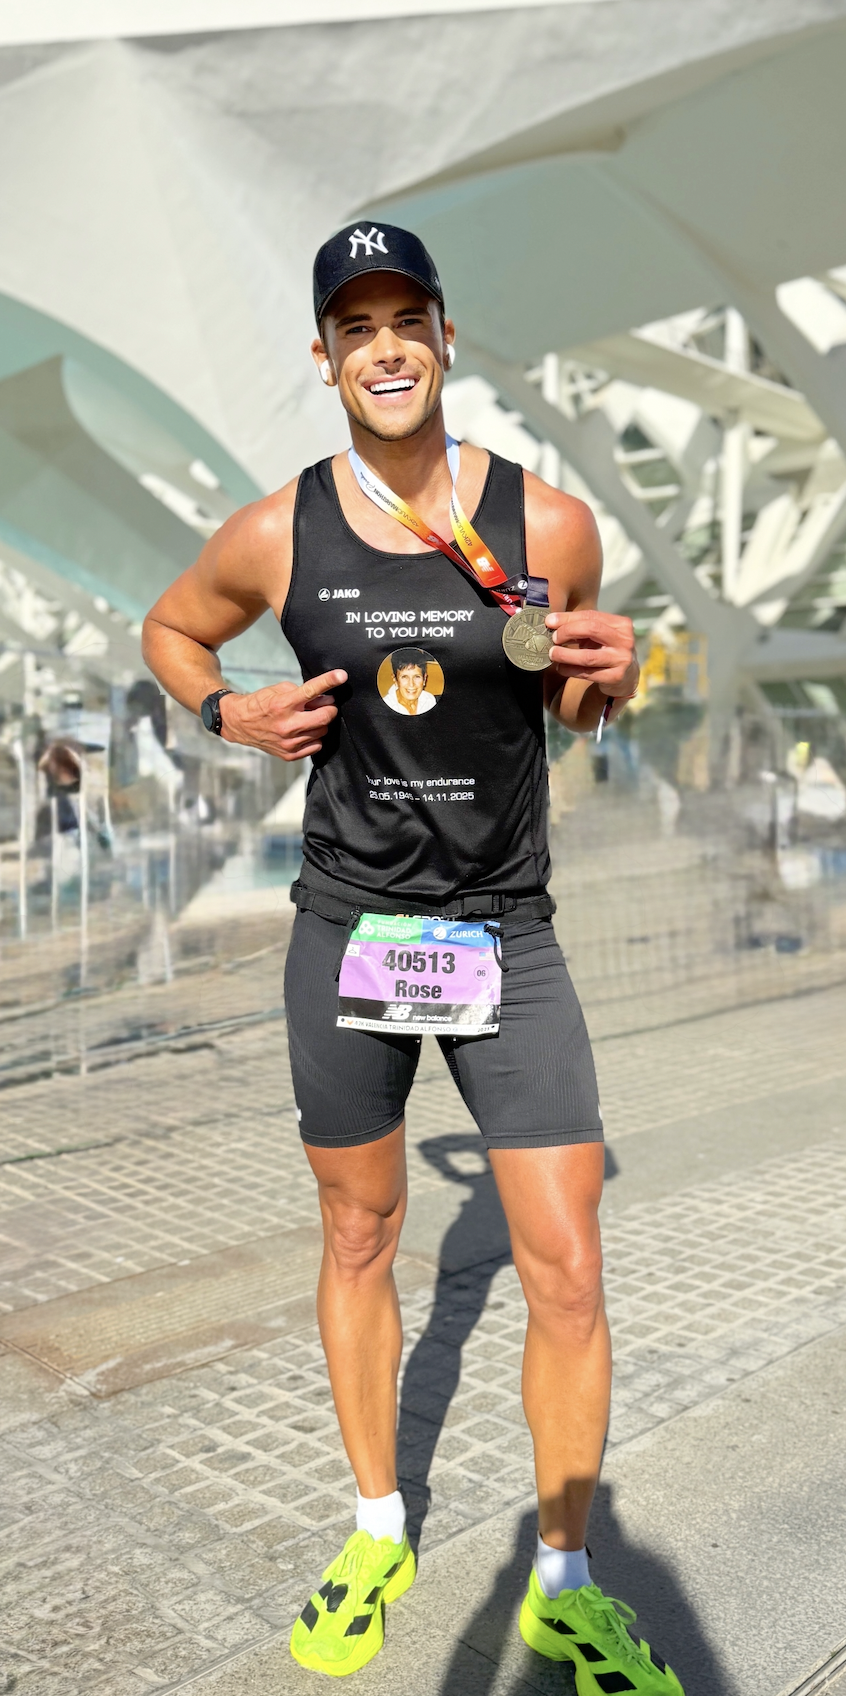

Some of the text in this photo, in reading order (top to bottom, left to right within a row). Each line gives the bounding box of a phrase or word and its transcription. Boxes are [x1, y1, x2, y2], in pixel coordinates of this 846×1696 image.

[332, 588, 361, 599] JAKO
[345, 610, 475, 624] IN LOVING MEMORY
[365, 626, 454, 639] TO YOU MOM
[383, 776, 400, 786] love
[411, 781, 424, 789] my
[426, 777, 476, 788] endurance
[422, 791, 475, 802] 14.11.2025
[377, 925, 412, 934] TRINIDAD
[450, 930, 484, 938] ZURICH
[376, 932, 412, 940] ALFONSO
[382, 949, 456, 974] 40513
[476, 969, 486, 977] 06
[395, 979, 442, 999] Rose
[427, 1014, 453, 1022] balance
[389, 1024, 419, 1032] TRINIDAD
